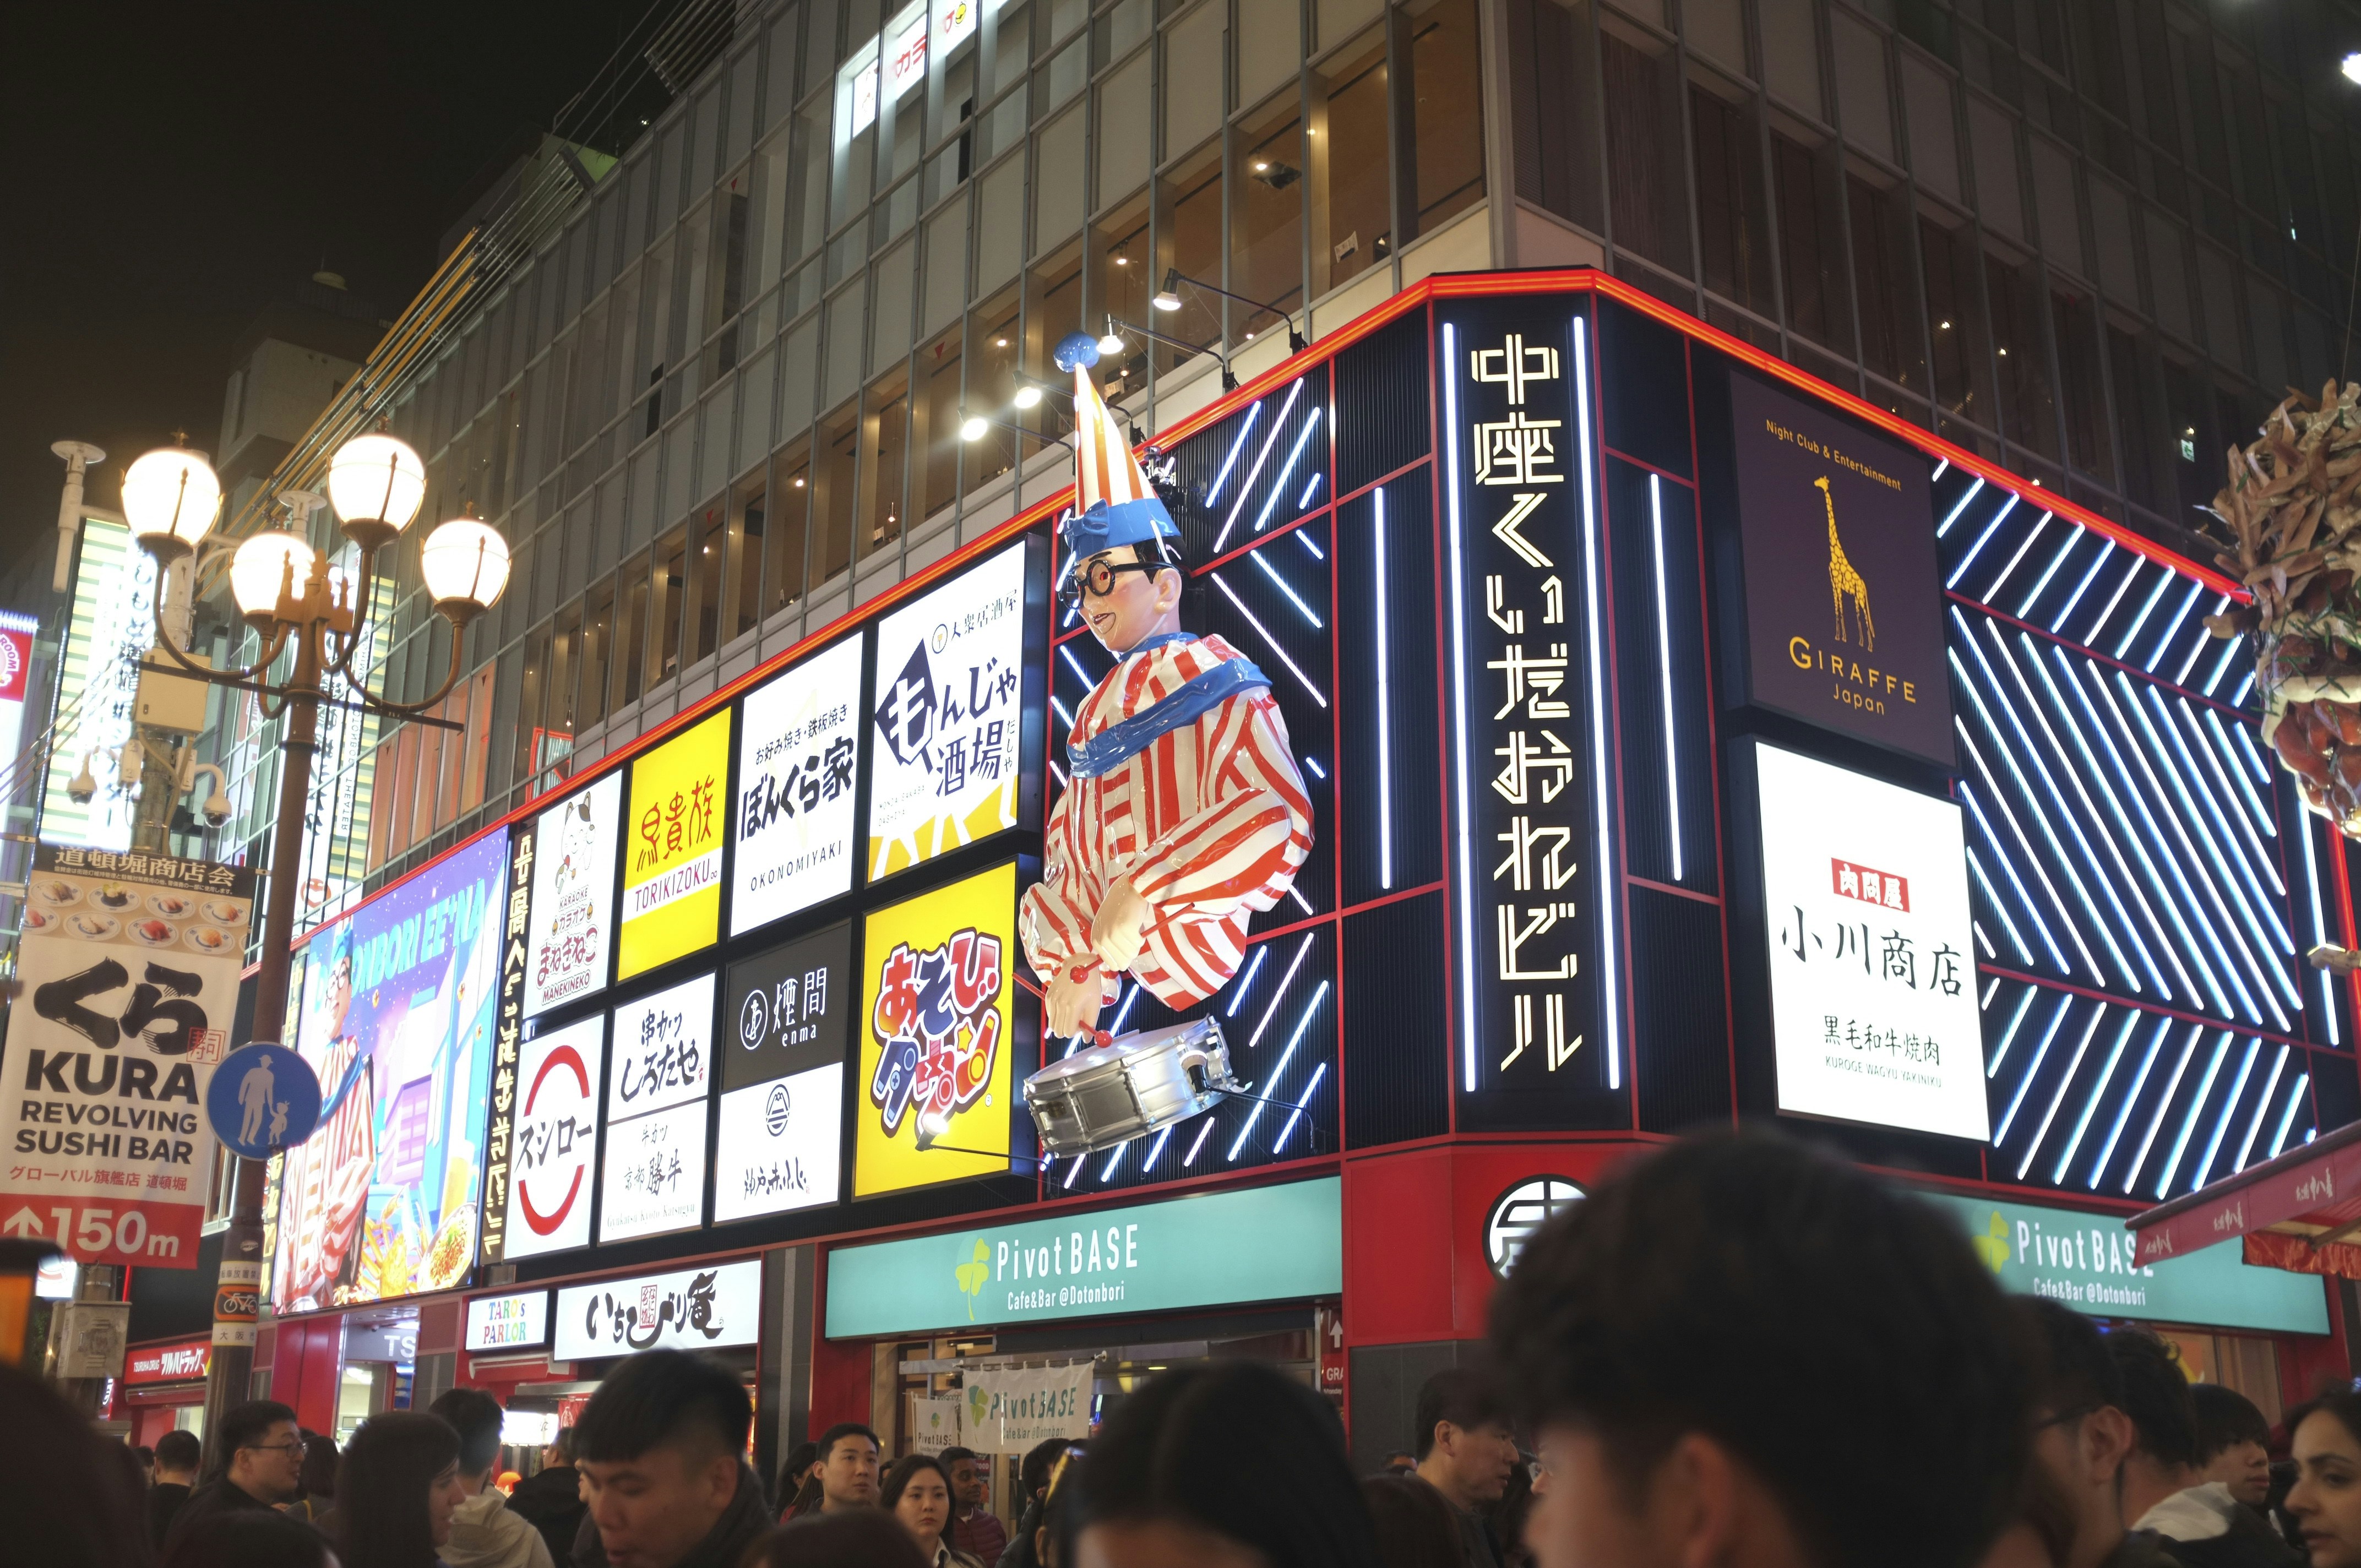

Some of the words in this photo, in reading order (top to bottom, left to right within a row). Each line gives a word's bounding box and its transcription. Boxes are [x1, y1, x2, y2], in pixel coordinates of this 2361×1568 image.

[1766, 419, 1794, 443] Night
[1797, 426, 1819, 456] Club
[1823, 445, 1831, 460] &
[1834, 449, 1902, 491] Entertainment
[951, 589, 1018, 641] 大衆居酒屋
[1789, 636, 1916, 704] GIRAFFE
[888, 656, 1018, 769] もんじゃ
[1471, 333, 1582, 1072] 中座くいだおれビル
[1833, 683, 1884, 716] Japan
[756, 703, 848, 766] お好み焼き・鉄板焼き
[936, 719, 1004, 797] 酒場
[1004, 718, 1016, 772] だしや
[740, 736, 855, 841] ぼんくら家
[637, 774, 715, 872] 鳥貴族
[55, 845, 236, 887] 道頓堀商店会
[635, 857, 710, 913] TORIKIZOKU
[750, 840, 842, 891] OKONOMIYAKI
[1839, 863, 1905, 911] 肉問屋
[559, 887, 589, 908] KARAOKE
[559, 907, 586, 930] カラオケ
[537, 927, 598, 987] まねきねこ
[1782, 905, 1962, 997] 小川商店
[34, 955, 208, 1055] くら
[542, 972, 590, 1003] MANEKINEKO
[773, 967, 828, 1033] 煙間
[876, 931, 999, 1037] あそび
[641, 1009, 682, 1047] 串カツ
[782, 1024, 817, 1047] enma
[25, 1049, 199, 1104] KURA
[1826, 1055, 1863, 1074] KUROGE
[1866, 1063, 1898, 1080] WAGYU
[1901, 1069, 1942, 1089] YAKINIKU
[20, 1100, 197, 1135] REVOLVING
[641, 1124, 668, 1147] 牛カツ
[14, 1129, 121, 1157] SUSHI
[127, 1135, 193, 1164] BAR
[515, 1114, 593, 1173] スシロー
[9, 1166, 141, 1187] グローバル旗艦店
[146, 1174, 188, 1191] 道頓堀
[51, 1207, 179, 1257] 150m
[1007, 1288, 1056, 1311] Cafe&Bar
[1059, 1280, 1125, 1307] @Dotonbori
[2034, 1277, 2083, 1302] Cafe&Bar
[2086, 1280, 2146, 1307] @Dotonbori
[483, 1321, 526, 1344] PARLOR
[161, 1348, 204, 1376] ツルハドラッグ
